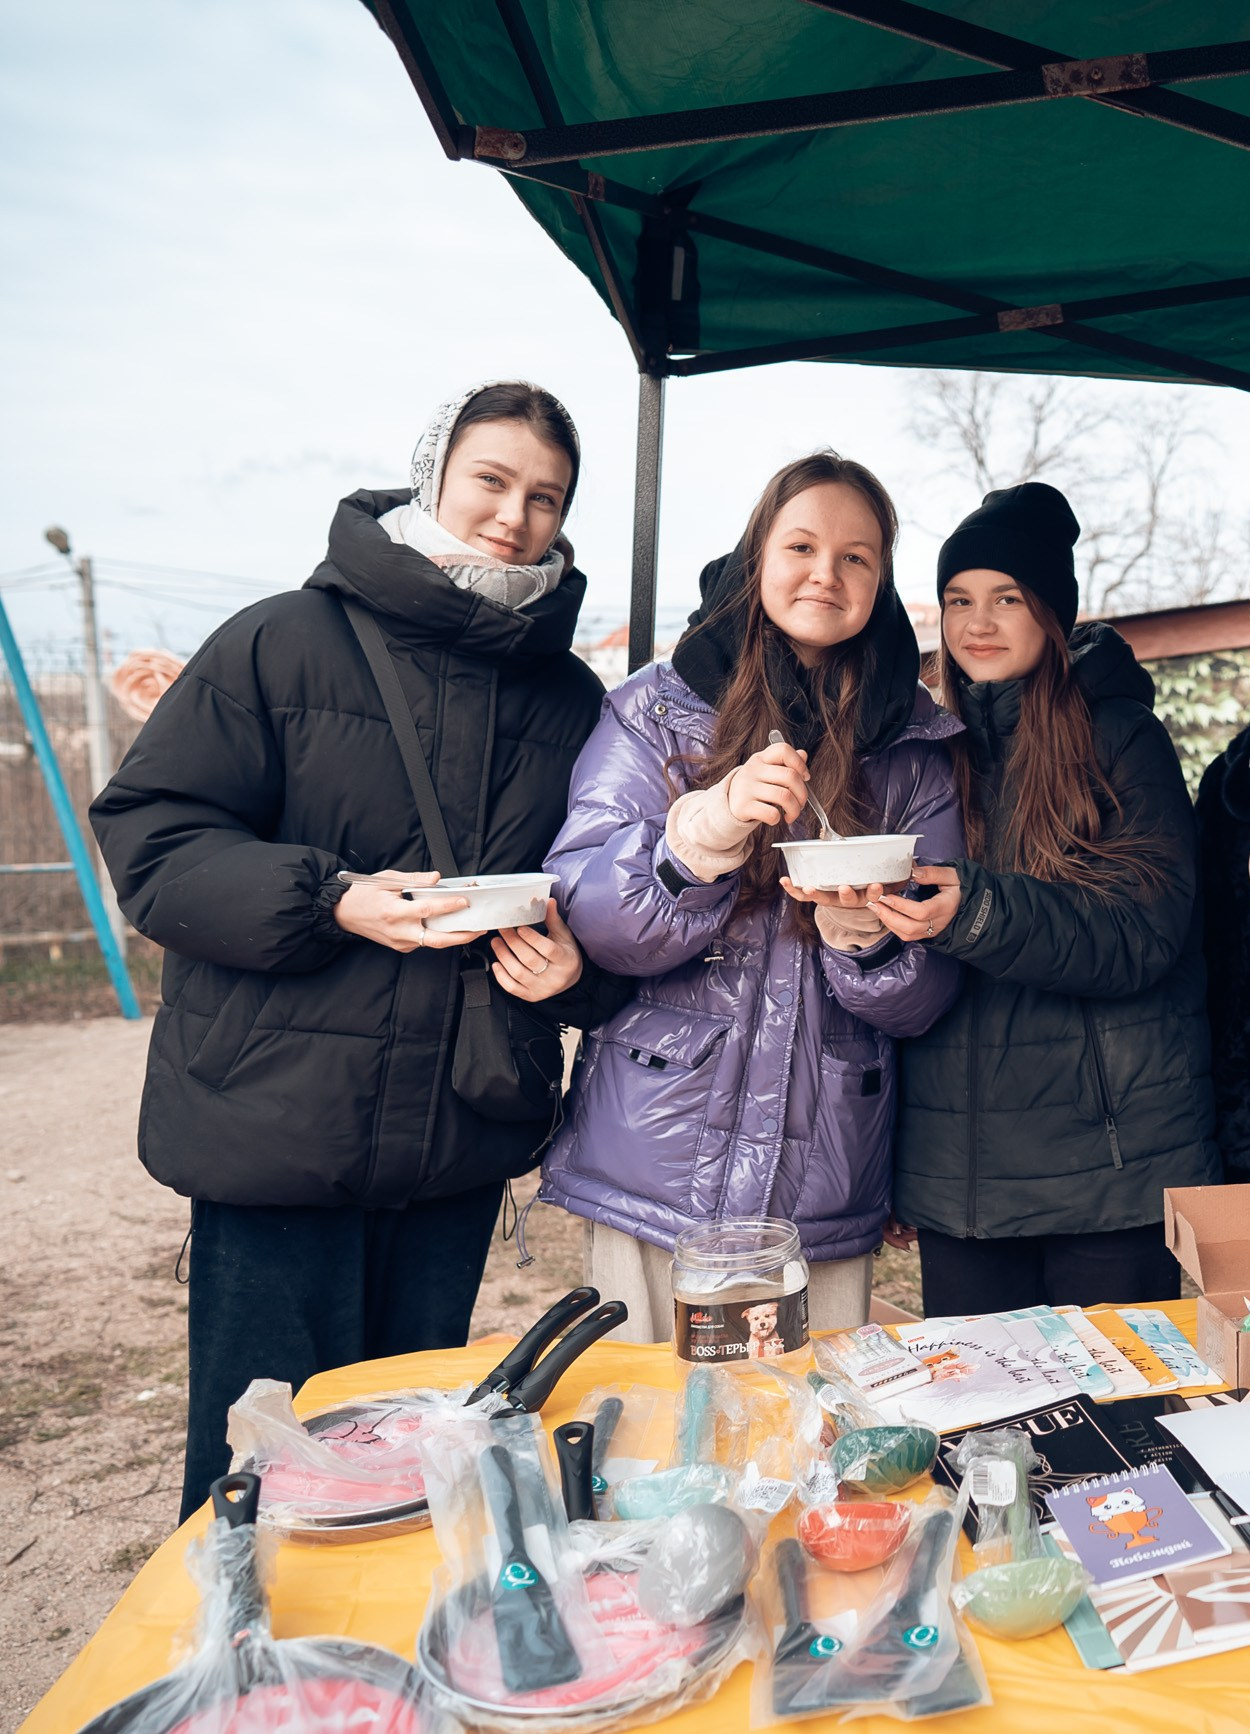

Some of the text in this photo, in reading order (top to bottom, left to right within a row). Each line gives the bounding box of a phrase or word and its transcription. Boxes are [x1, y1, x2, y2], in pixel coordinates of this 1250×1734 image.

[974, 906, 988, 931] SHIELD
[908, 1338, 983, 1353] Happiness
[984, 1349, 996, 1357] is
[995, 1357, 1016, 1368] the
[1008, 1368, 1034, 1384] best
[1068, 1364, 1092, 1379] best
[1099, 1359, 1124, 1374] best
[1109, 1539, 1193, 1568] Побеждай
